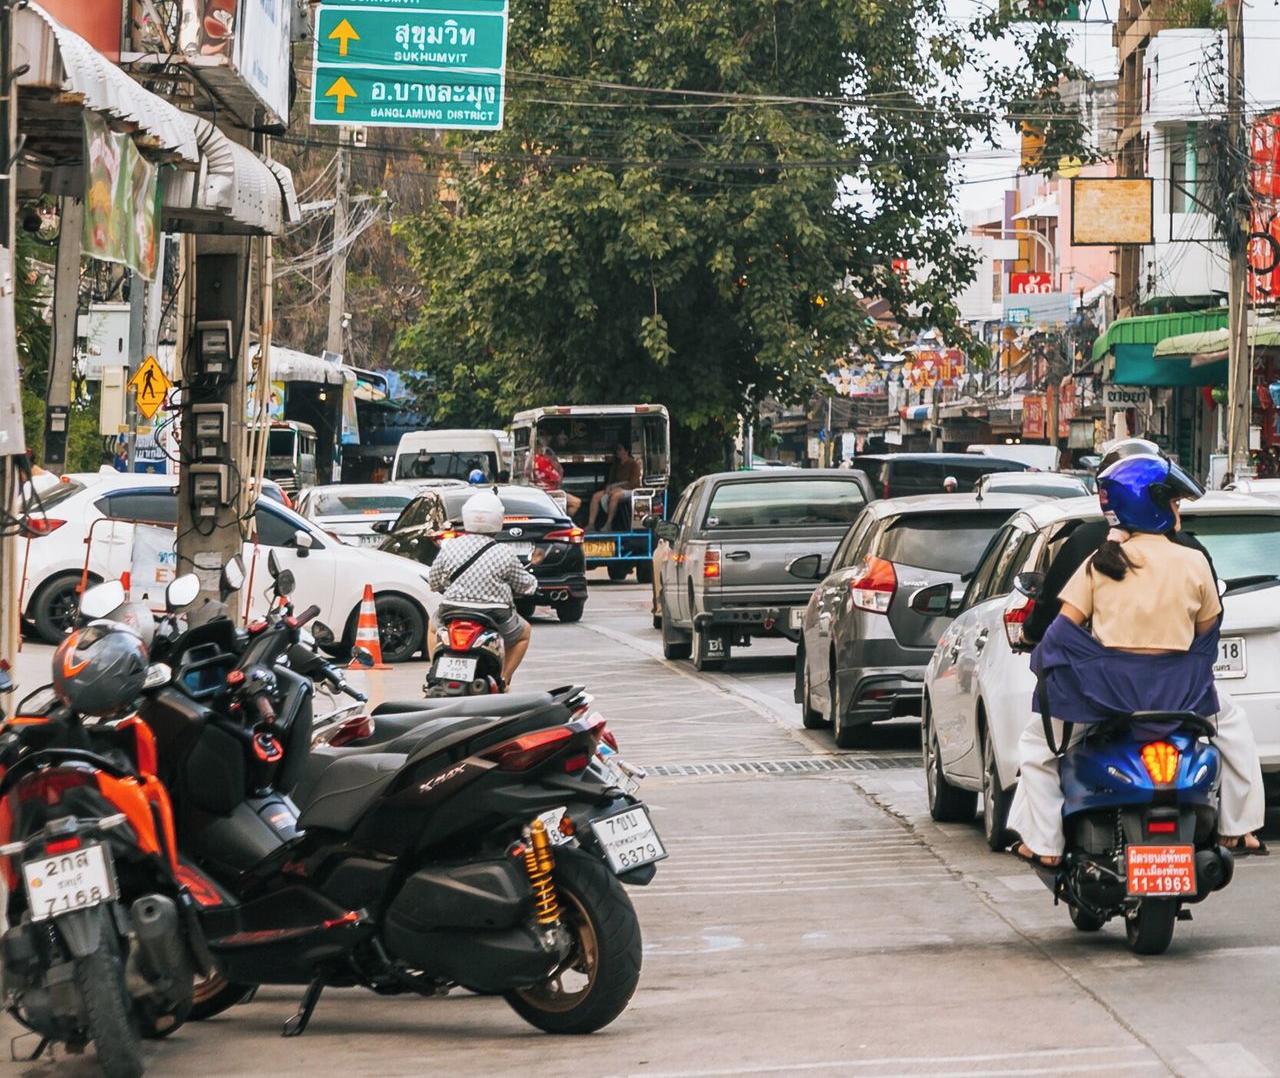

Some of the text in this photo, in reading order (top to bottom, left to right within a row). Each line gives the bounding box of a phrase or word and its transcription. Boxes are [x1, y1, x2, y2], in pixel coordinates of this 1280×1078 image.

[395, 19, 475, 51] สุขุมวิท
[394, 52, 467, 63] SUKHUMVIT
[371, 82, 495, 110] อ.บางละมุง
[371, 109, 494, 121] BANGLAMUNG DISTRICT
[619, 843, 656, 867] 8379
[1132, 877, 1191, 891] 11-1963
[45, 886, 101, 917] 7168
